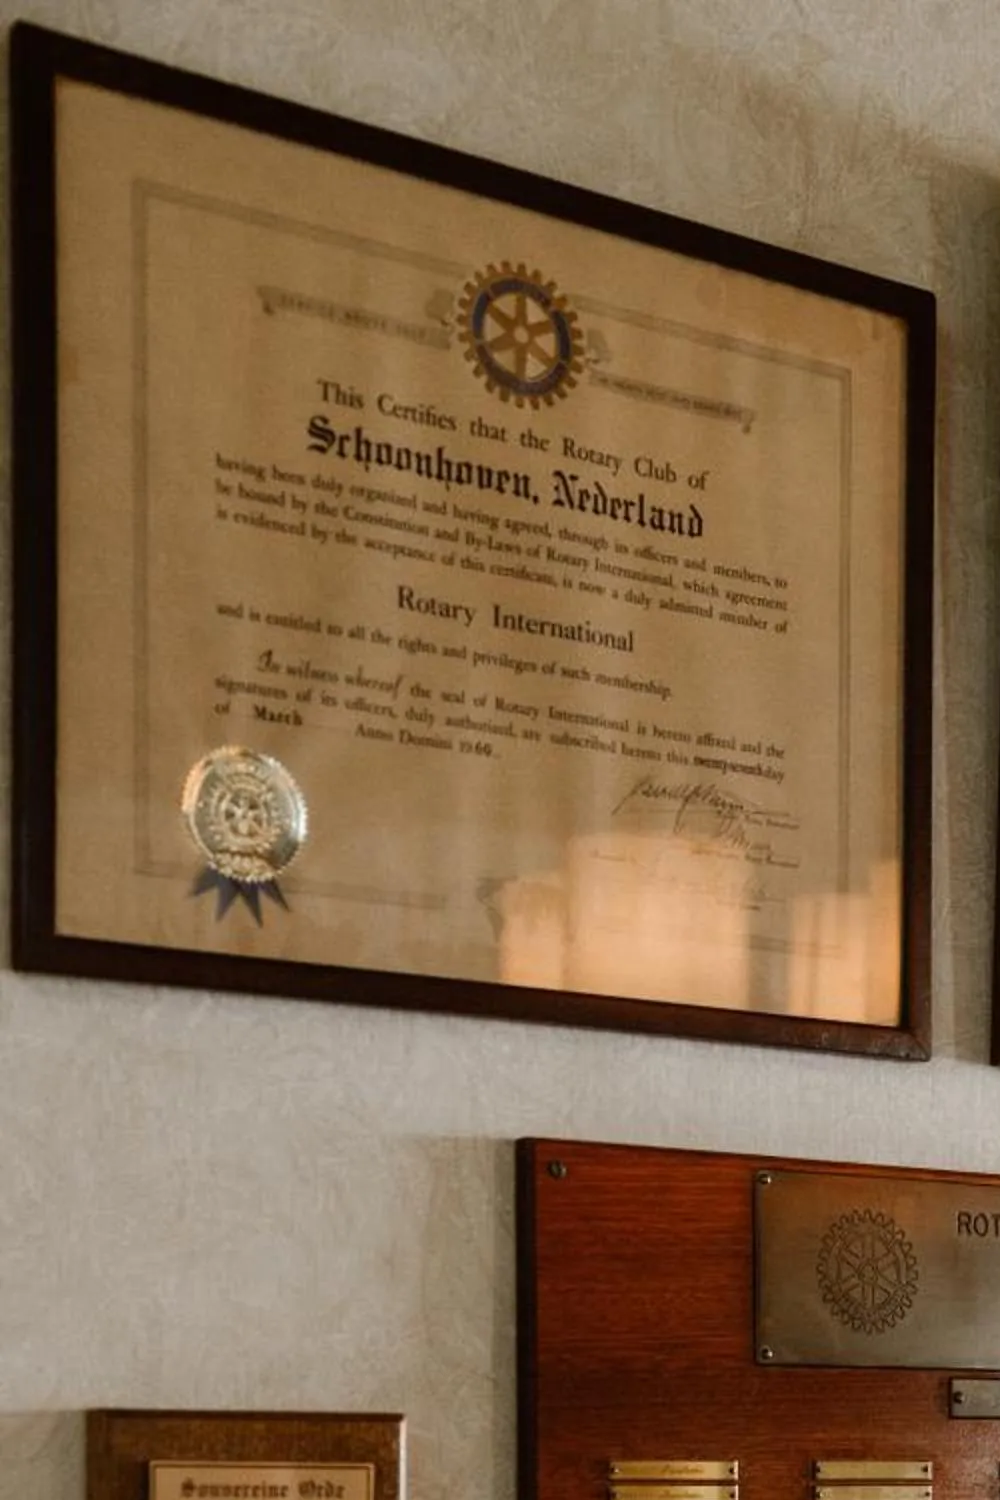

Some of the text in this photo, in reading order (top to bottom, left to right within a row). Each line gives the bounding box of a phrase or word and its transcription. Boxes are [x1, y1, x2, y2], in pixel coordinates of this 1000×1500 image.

[317, 379, 709, 491] This Certifies that the Rotary Club of
[314, 499, 338, 517] the
[433, 525, 459, 542] and
[422, 496, 447, 515] and
[684, 556, 707, 572] and
[552, 469, 703, 538] Nederland
[397, 584, 634, 653] Rotary International
[442, 645, 467, 660] and
